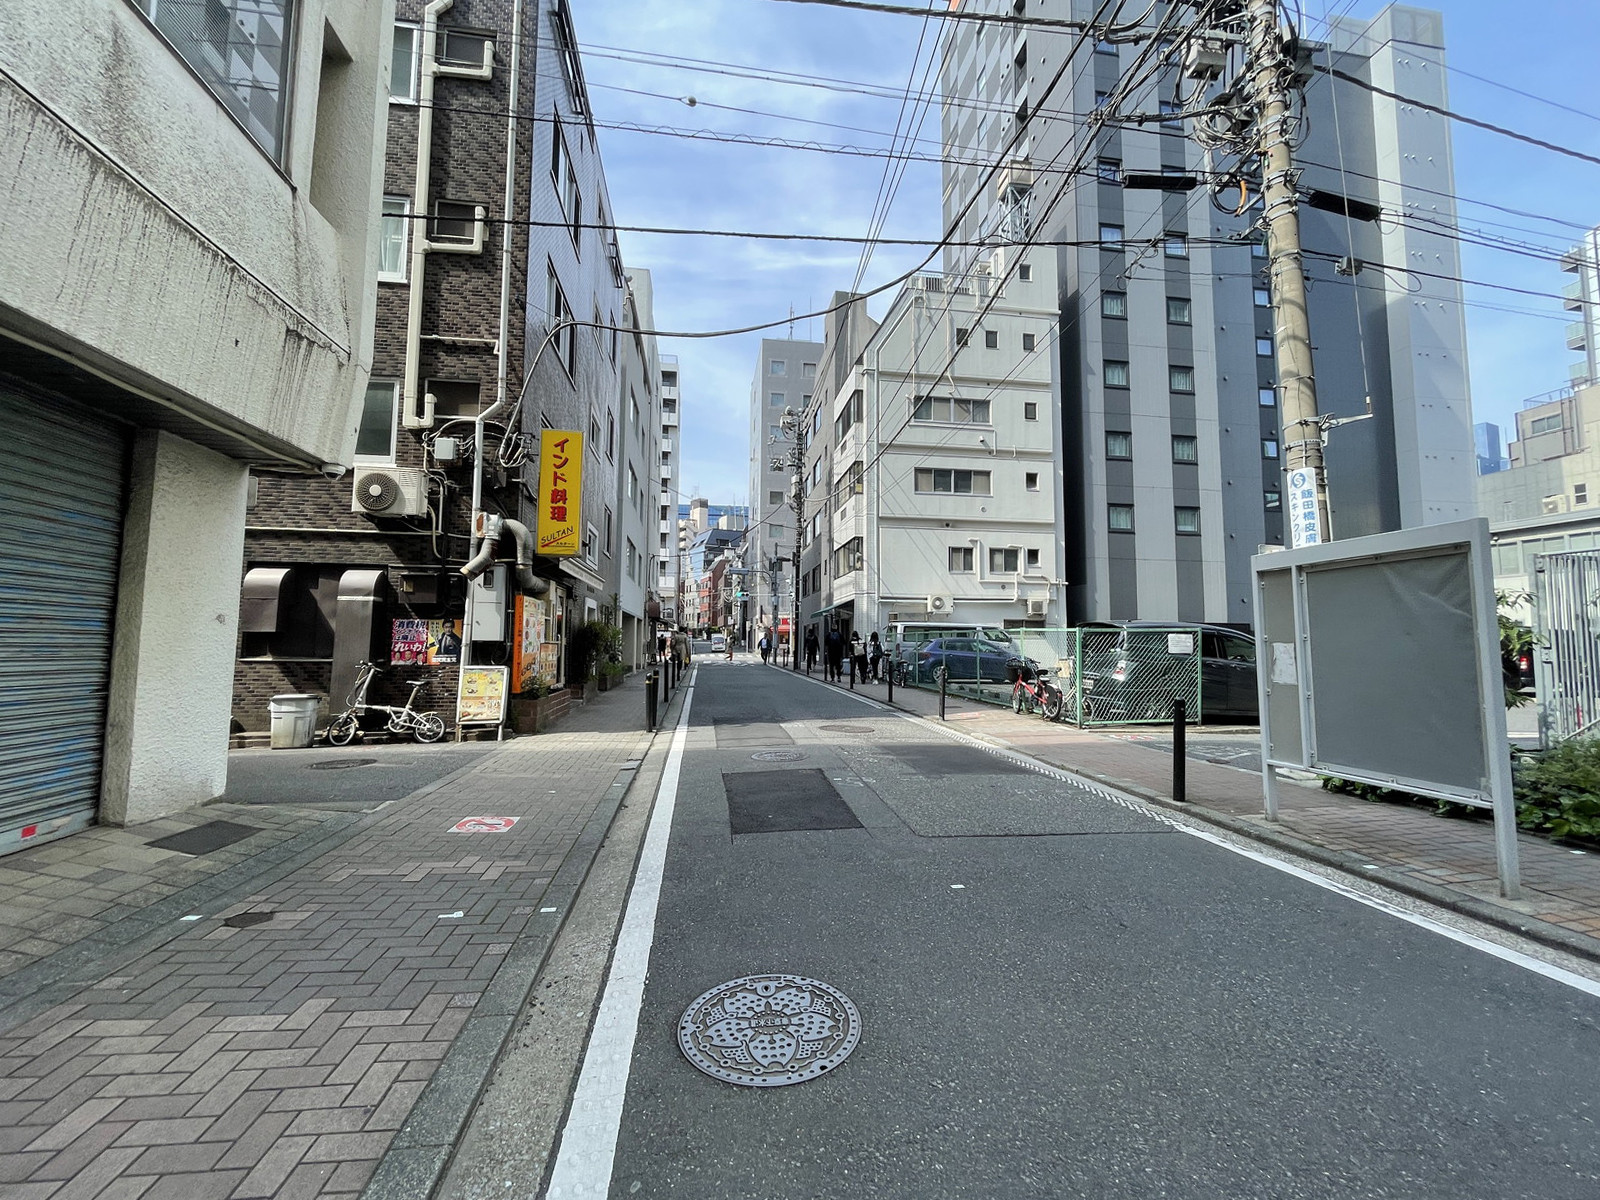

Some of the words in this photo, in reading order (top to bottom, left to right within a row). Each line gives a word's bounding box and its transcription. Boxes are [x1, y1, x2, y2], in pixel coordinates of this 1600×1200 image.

[549, 438, 569, 522] インド料理
[541, 525, 574, 545] SULTAN
[1301, 489, 1317, 544] 飯田橋皮膚
